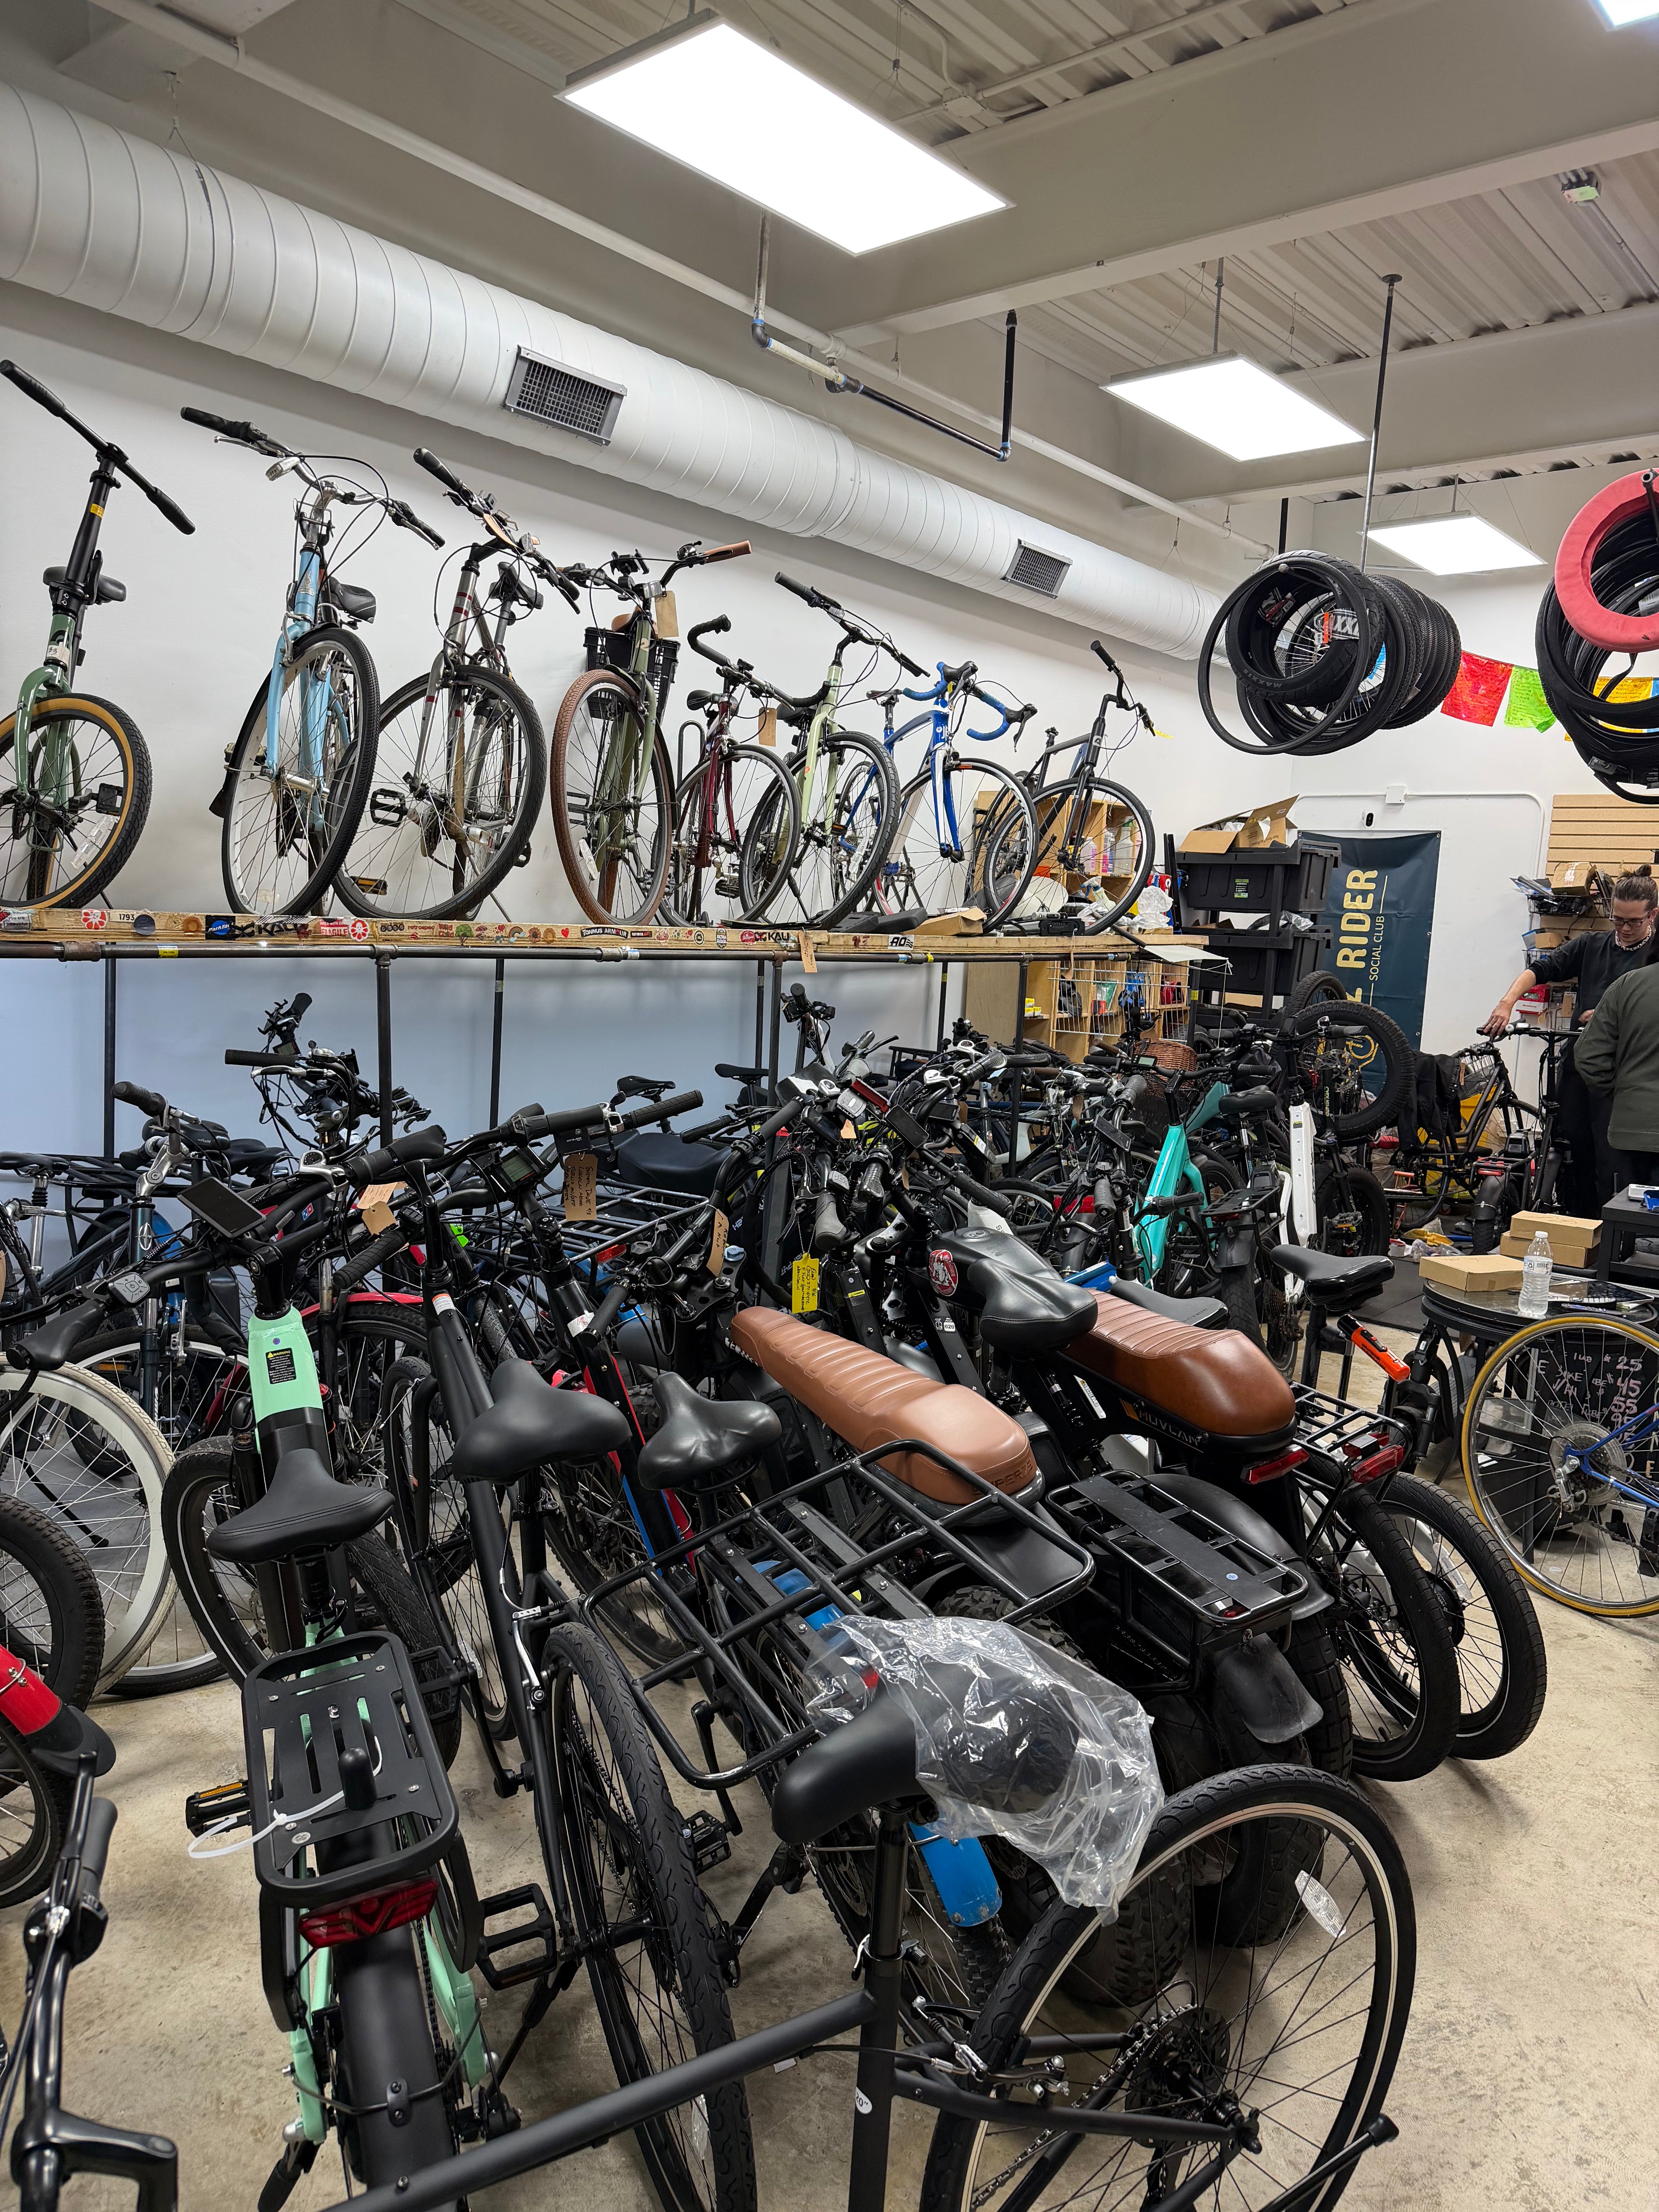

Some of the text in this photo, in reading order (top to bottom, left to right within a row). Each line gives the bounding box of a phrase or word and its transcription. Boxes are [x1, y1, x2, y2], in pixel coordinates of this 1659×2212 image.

[1243, 669, 1282, 688] MAXXIS
[1337, 869, 1378, 969] RIDER
[1369, 915, 1385, 981] SOCIAL CLUB
[1616, 1356, 1643, 1372] 25
[1616, 1377, 1642, 1397] 45
[1611, 1396, 1638, 1414] 55
